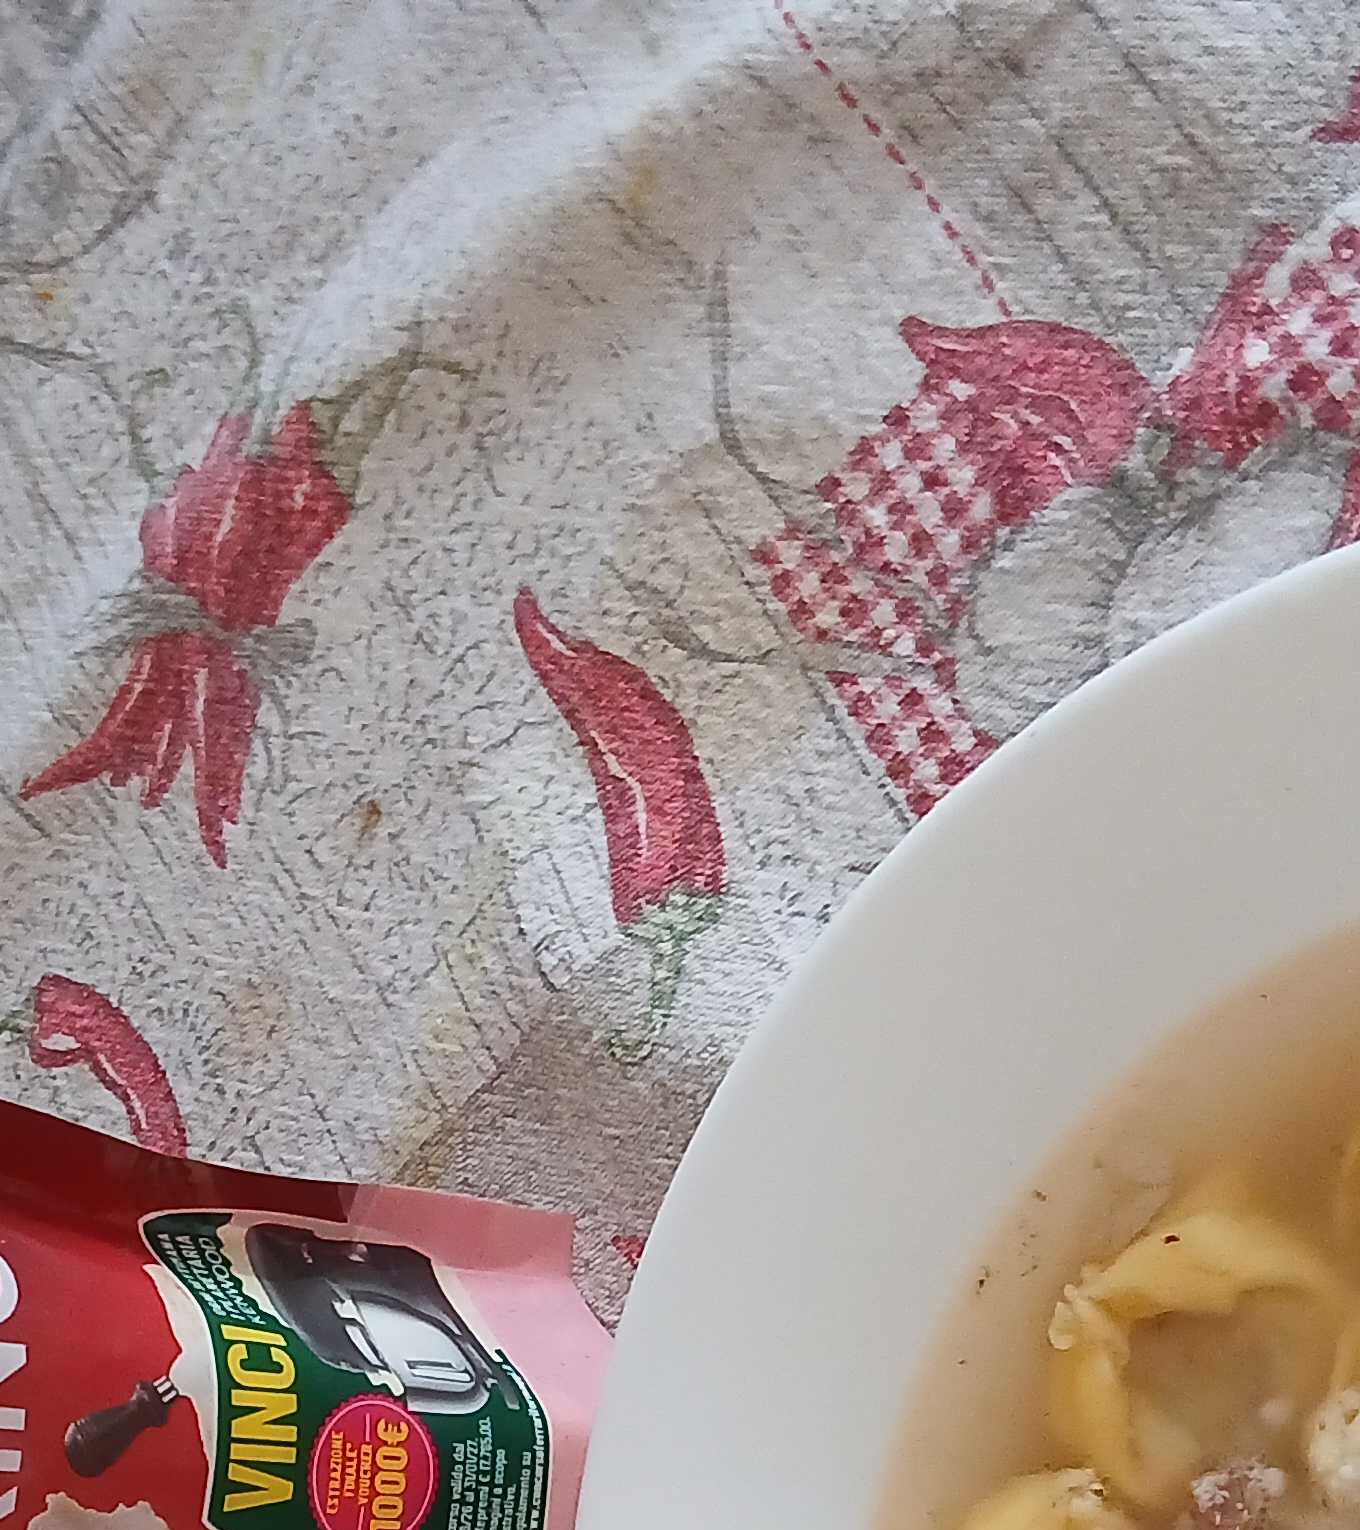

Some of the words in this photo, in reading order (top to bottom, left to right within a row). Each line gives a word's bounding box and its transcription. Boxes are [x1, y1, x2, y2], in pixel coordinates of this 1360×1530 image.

[198, 1237, 266, 1325] KENWOOD
[220, 1324, 298, 1513] VINCI
[452, 1442, 465, 1462] dal
[494, 1449, 508, 1485] scopo
[522, 1451, 532, 1466] su
[324, 1430, 345, 1515] ESTRAZIONE
[356, 1444, 373, 1506] VOUCHER
[450, 1464, 463, 1500] valido
[463, 1491, 475, 1503] al
